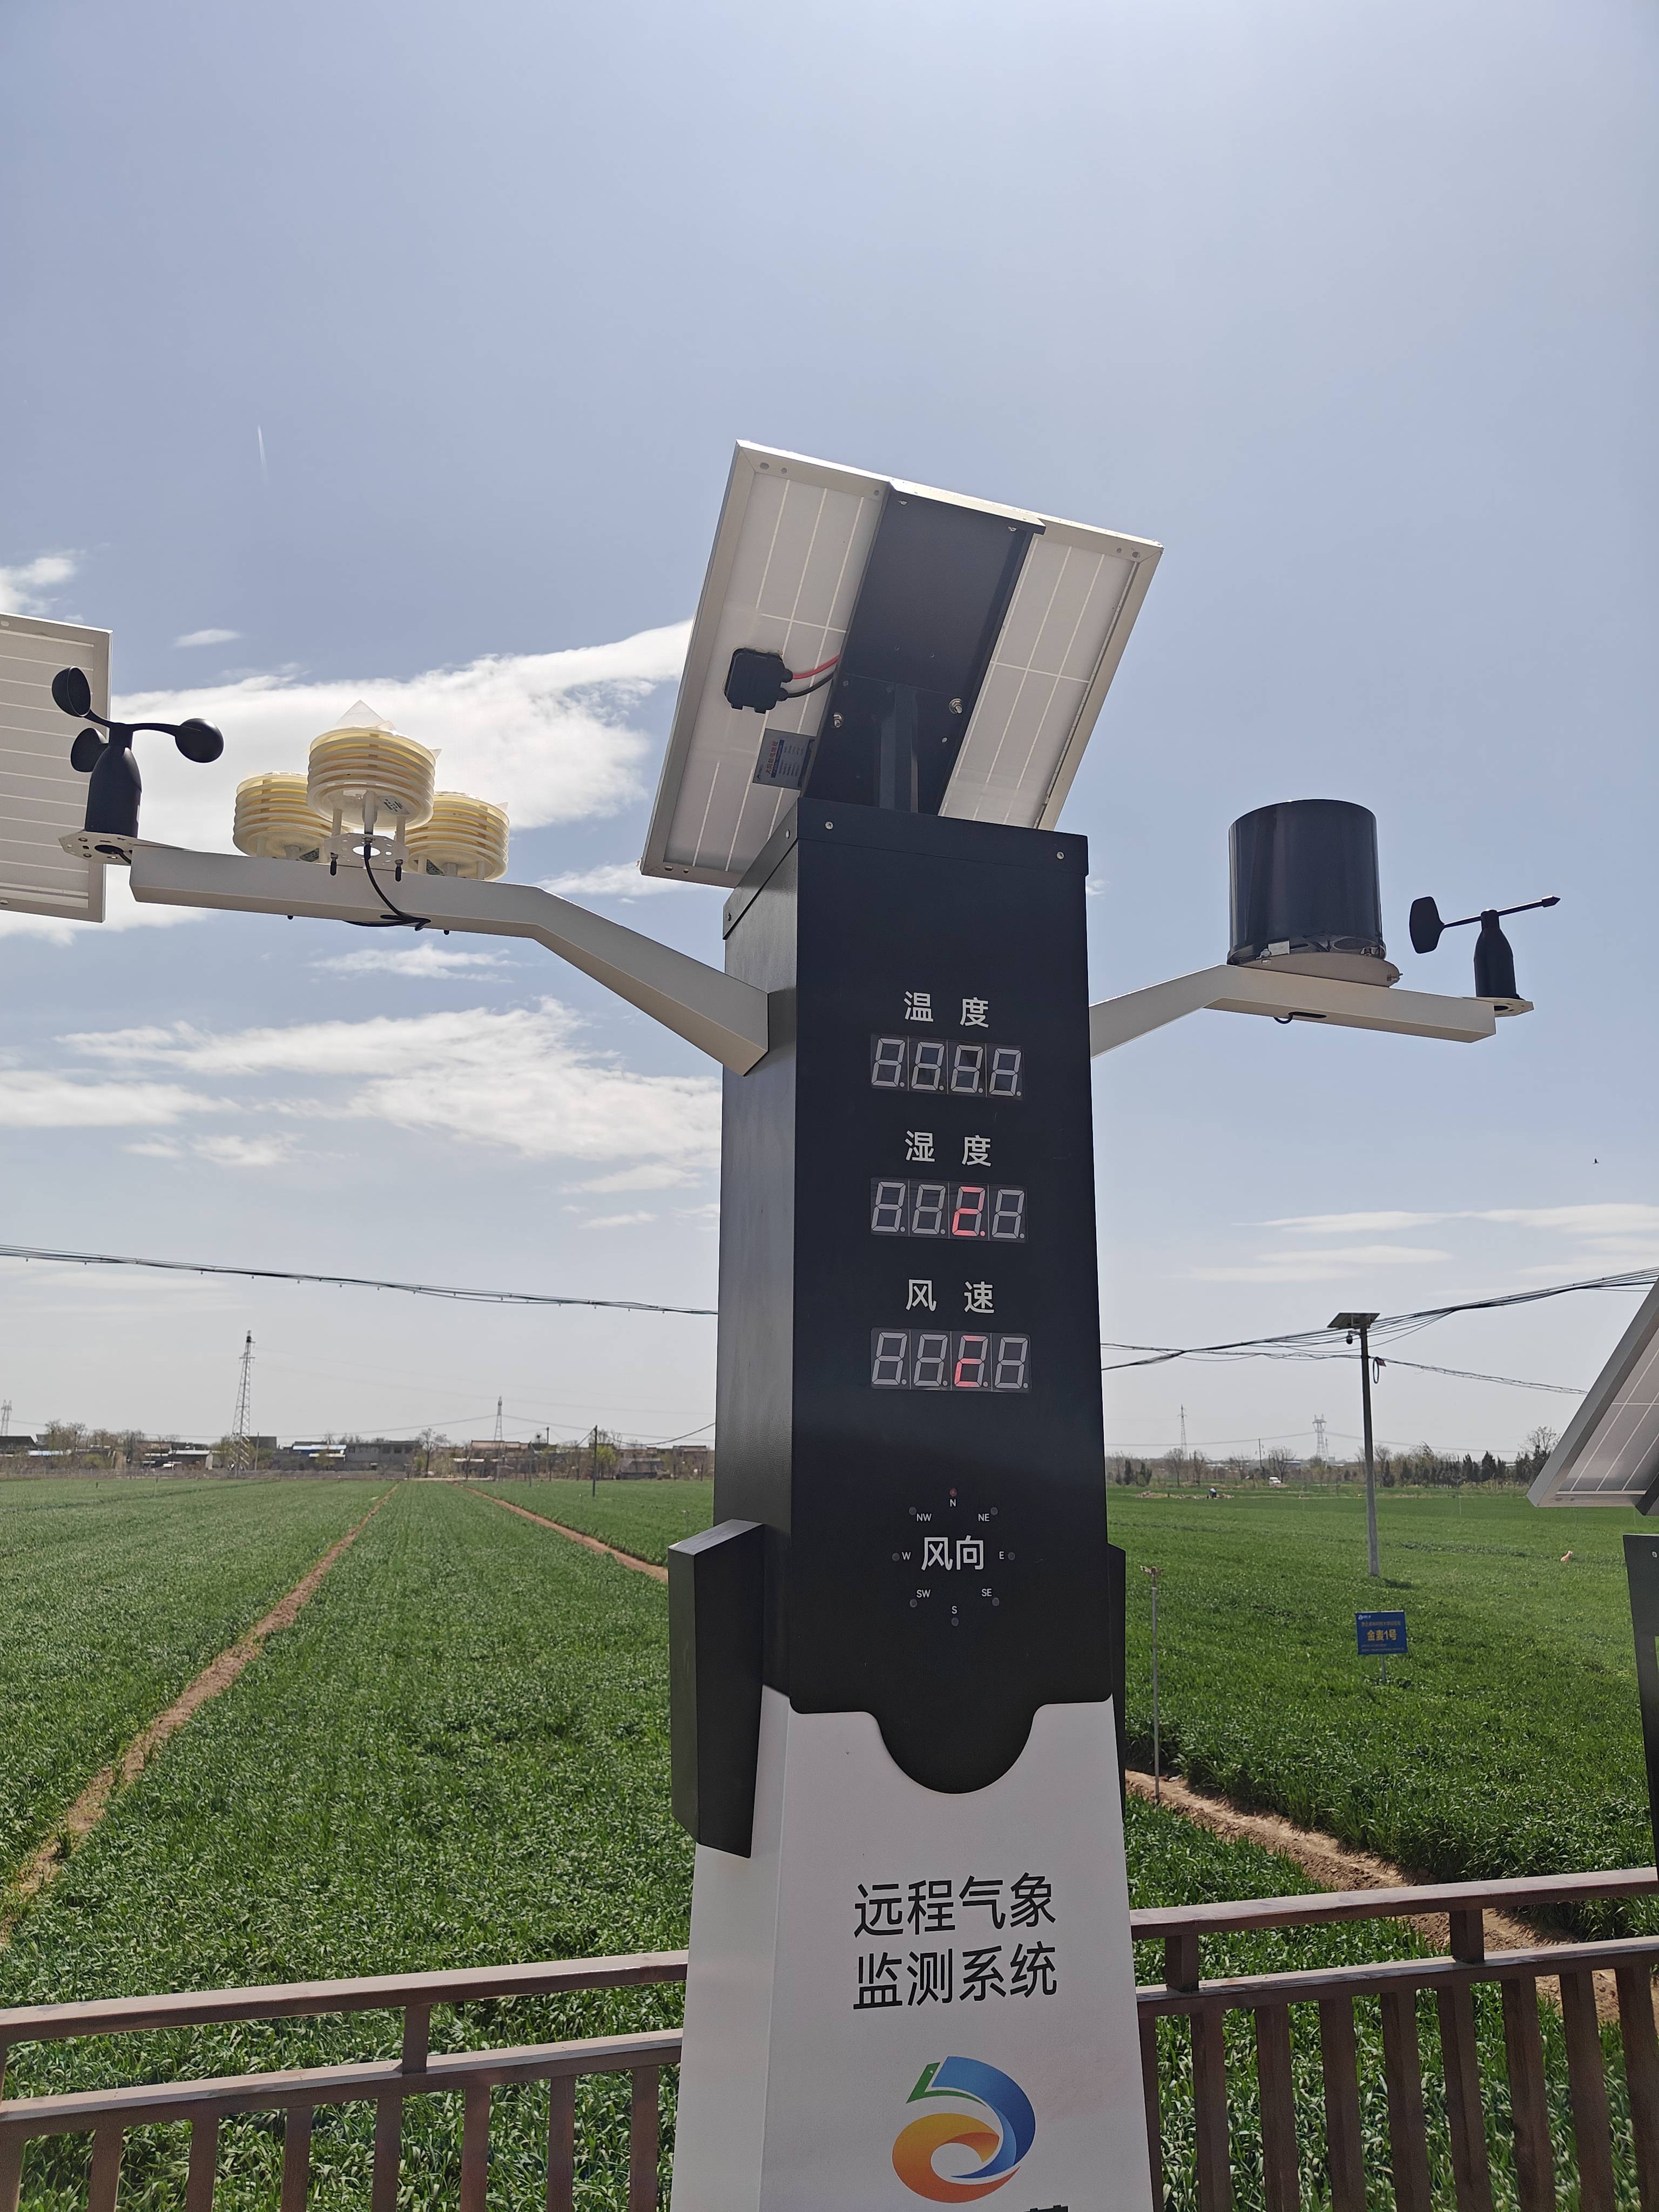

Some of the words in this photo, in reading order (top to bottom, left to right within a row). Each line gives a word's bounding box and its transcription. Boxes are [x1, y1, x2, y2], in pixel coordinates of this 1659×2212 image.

[903, 990, 934, 1022] 温
[960, 997, 989, 1028] 度
[905, 1130, 935, 1162] 湿
[961, 1135, 992, 1167] 度
[905, 1279, 937, 1312] 风
[964, 1281, 995, 1314] 速
[949, 1499, 956, 1507] N
[916, 1513, 932, 1522] NW
[978, 1514, 990, 1522] NE
[902, 1552, 911, 1560] W
[921, 1535, 984, 1571] 风向
[999, 1552, 1005, 1560] E
[916, 1589, 930, 1598] SW
[981, 1588, 992, 1597] SE
[951, 1606, 957, 1614] S
[854, 1872, 1056, 1938] 远程气象
[853, 1941, 1057, 2009] 监测系统
